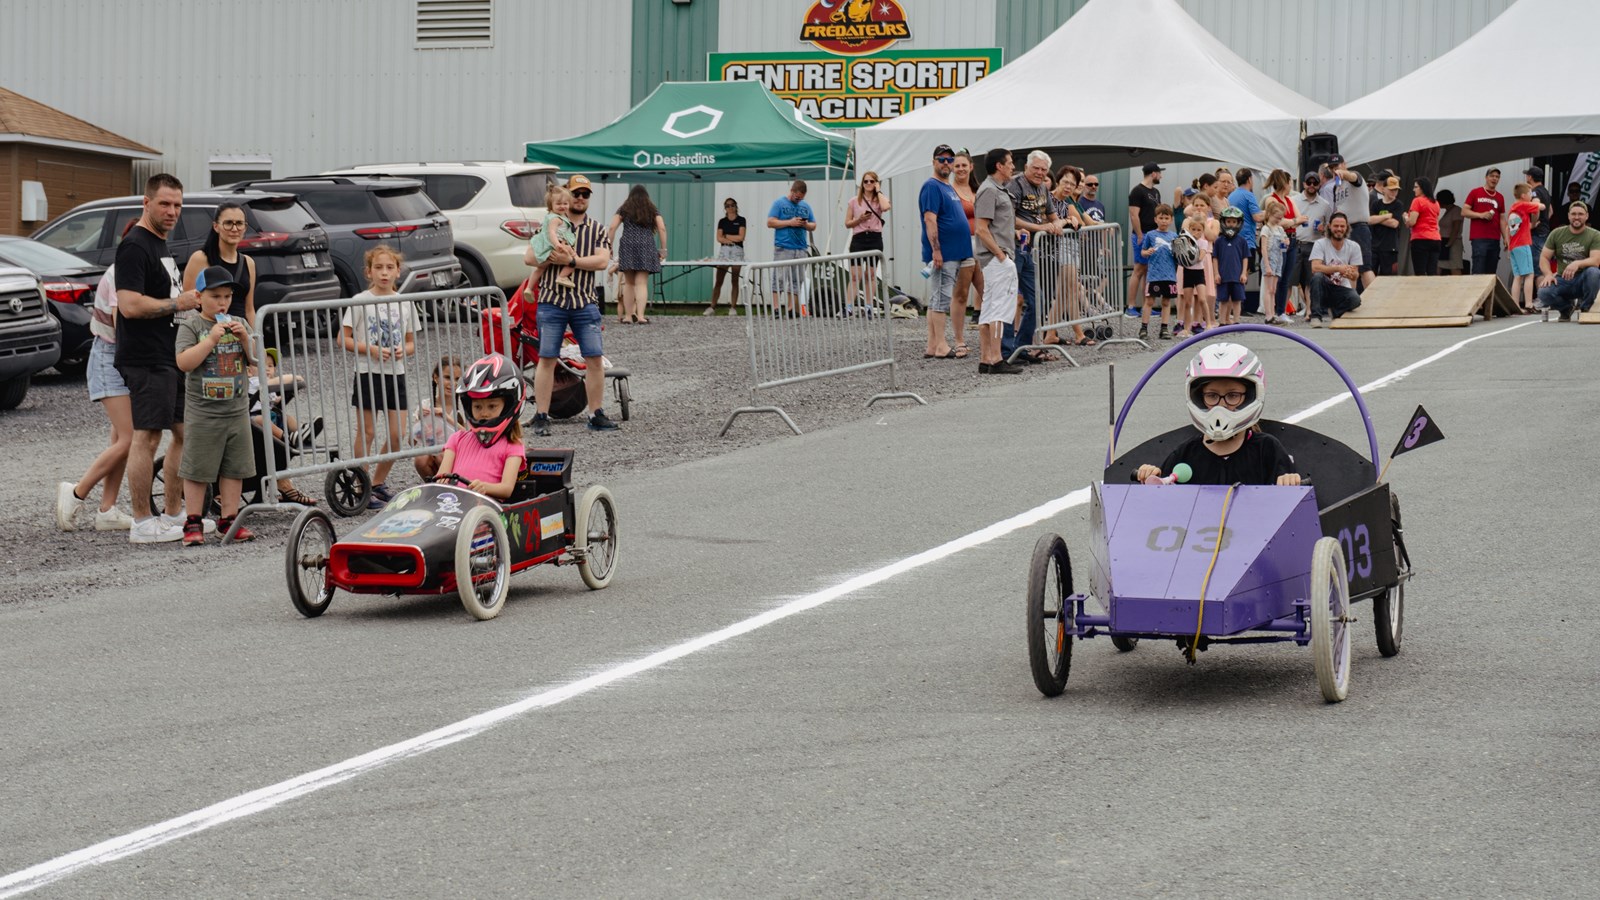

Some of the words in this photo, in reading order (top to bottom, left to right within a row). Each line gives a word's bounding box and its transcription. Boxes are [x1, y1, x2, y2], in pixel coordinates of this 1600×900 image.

[726, 63, 842, 90] CENTRE
[852, 61, 985, 89] SPORTIF
[784, 97, 901, 119] ACINE
[653, 153, 716, 167] Desjardins
[1404, 416, 1428, 449] 3
[524, 507, 541, 553] 29
[1145, 526, 1234, 553] 03
[1338, 523, 1373, 583] 03
